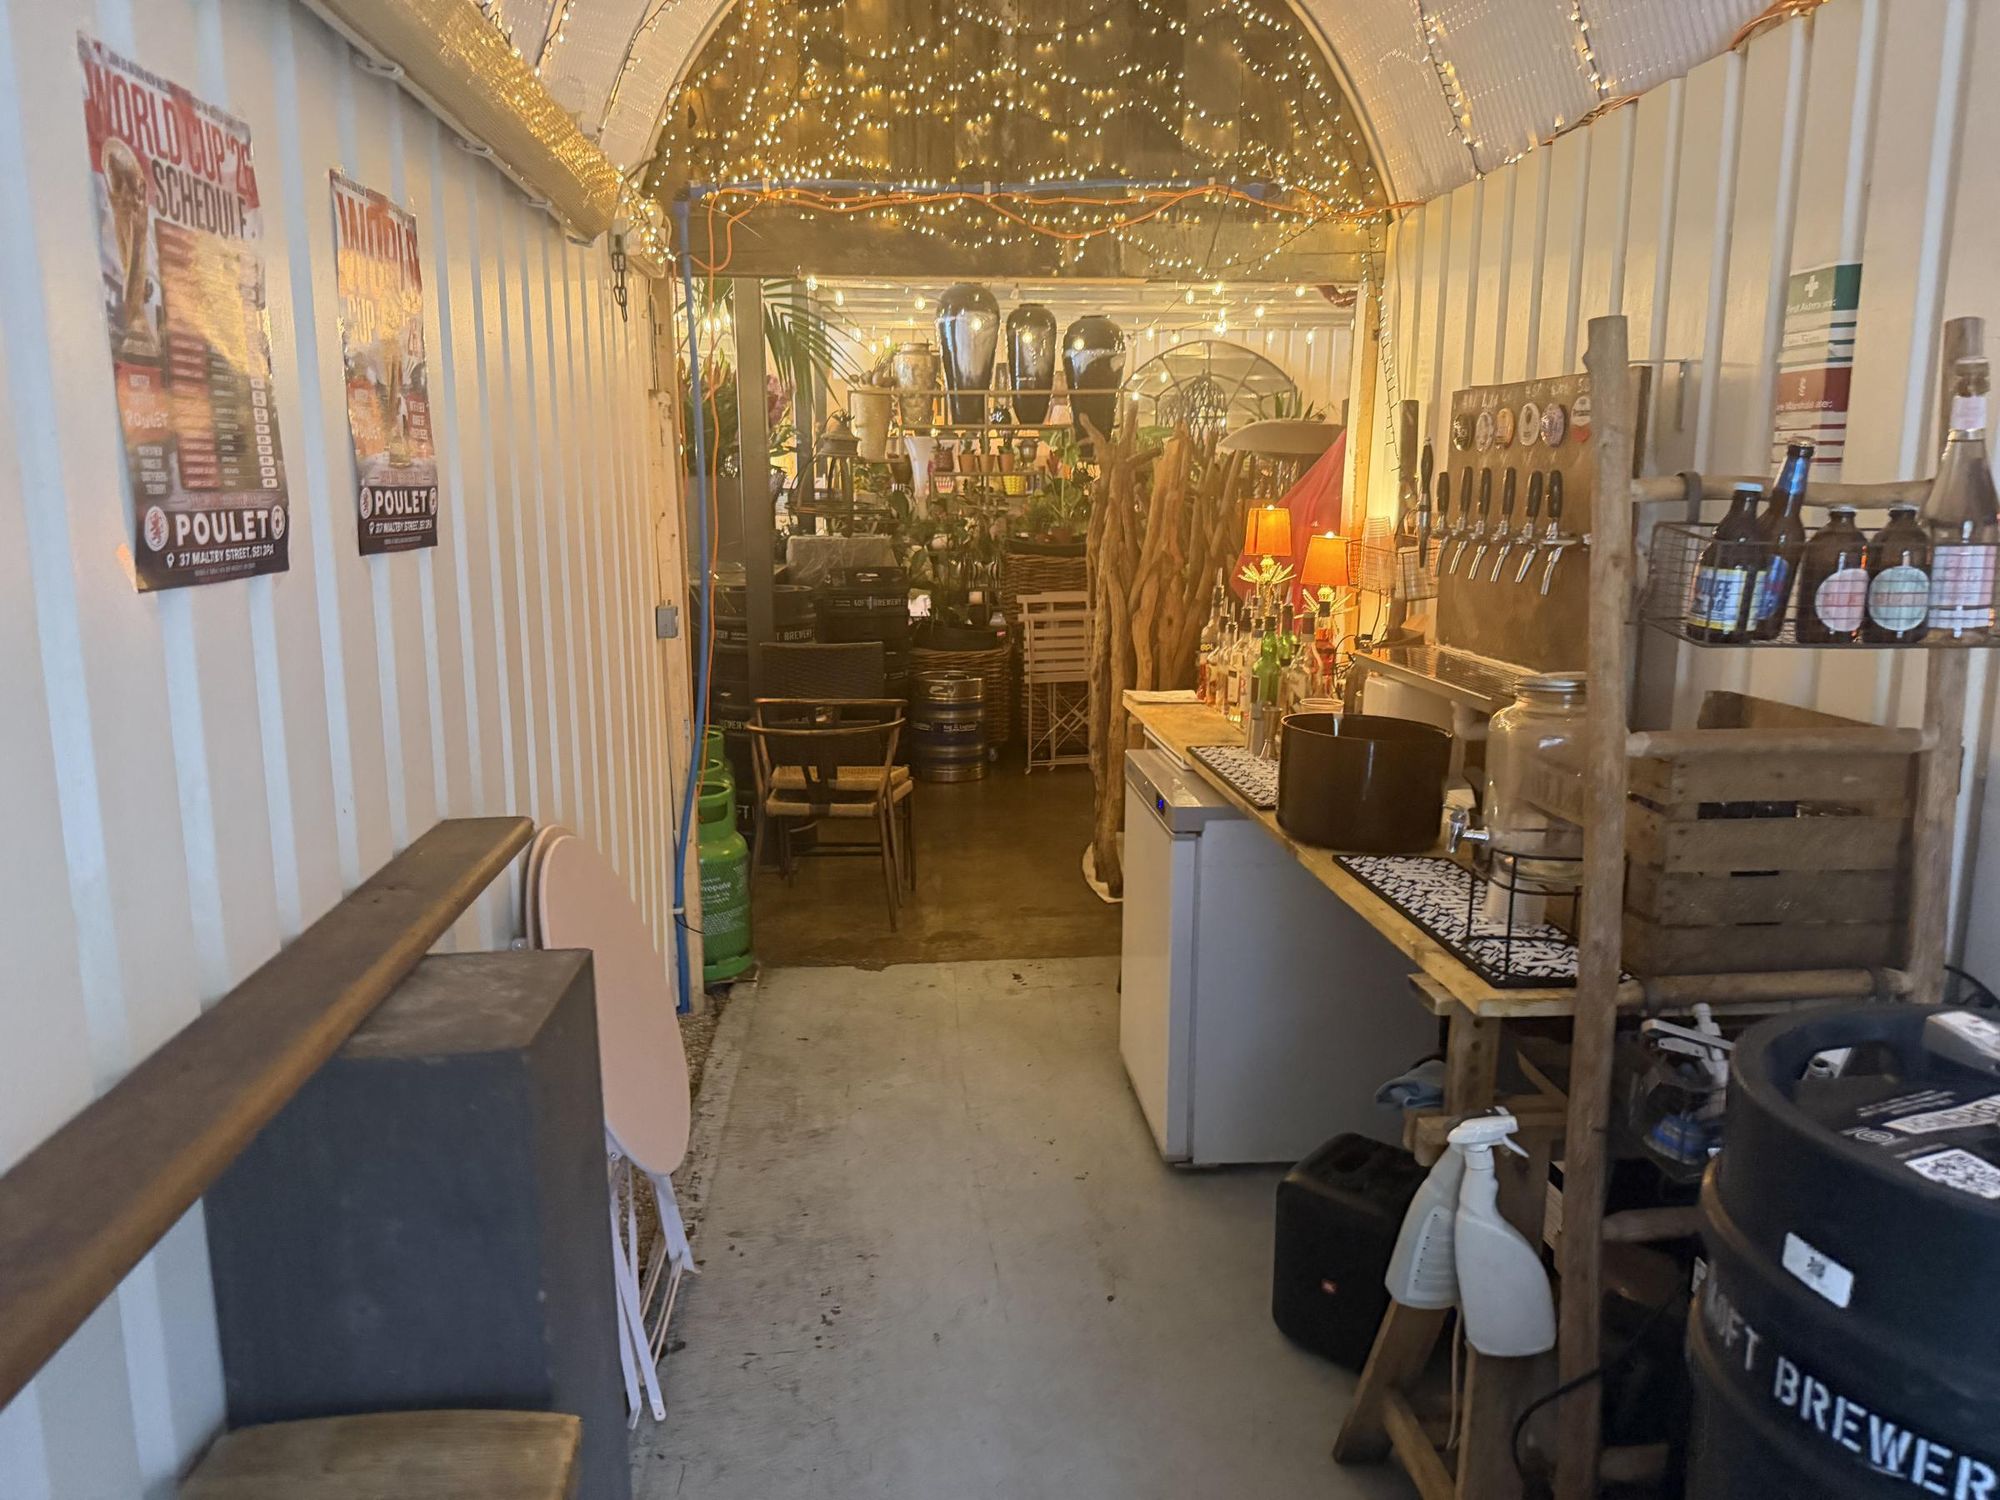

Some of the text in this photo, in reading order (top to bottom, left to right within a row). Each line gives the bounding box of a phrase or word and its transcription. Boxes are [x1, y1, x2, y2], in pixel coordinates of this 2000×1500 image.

[83, 60, 182, 166] WORLD
[185, 104, 224, 185] CUP
[152, 159, 247, 240] SCHEDULE
[175, 509, 268, 547] POULET
[374, 489, 428, 516] POULET
[179, 553, 191, 567] 37
[192, 549, 224, 566] MALTBY
[1773, 1355, 1999, 1500] BREWER
